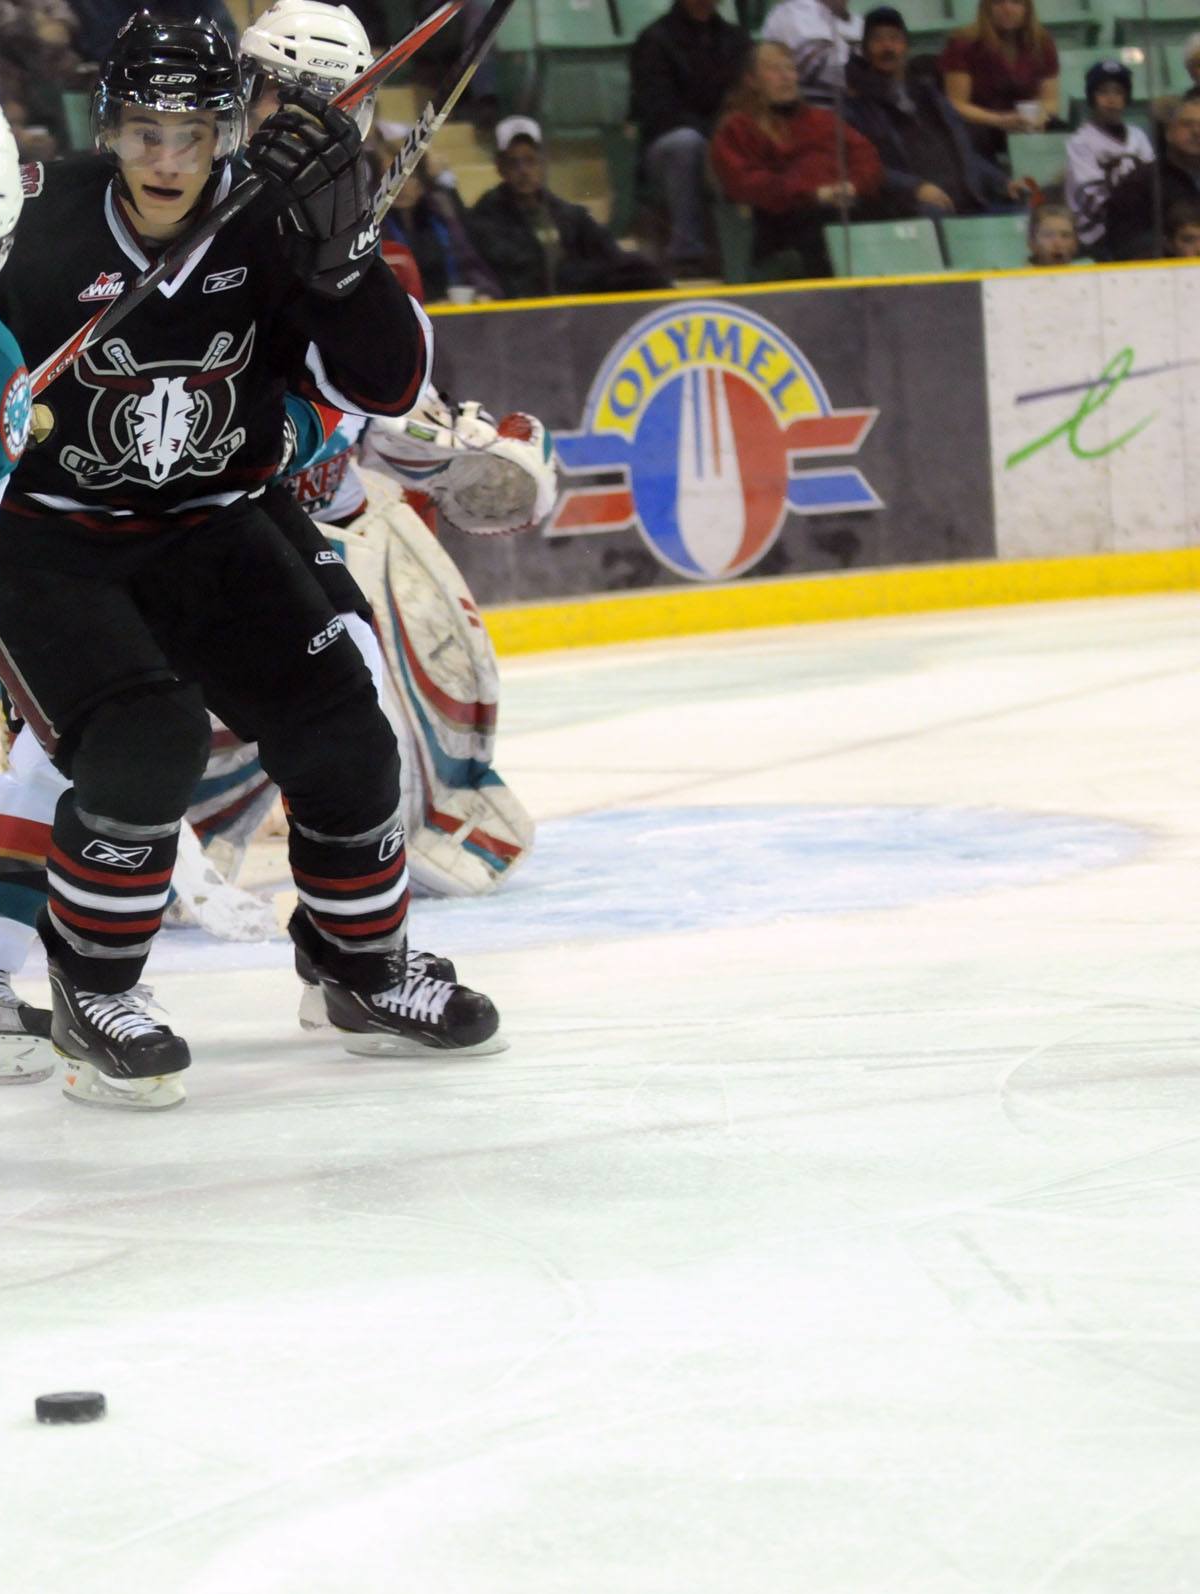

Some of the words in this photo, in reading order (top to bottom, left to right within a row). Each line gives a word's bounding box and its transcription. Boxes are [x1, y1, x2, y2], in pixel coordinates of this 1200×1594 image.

[312, 58, 346, 70] CCM
[153, 74, 194, 83] CCM
[87, 280, 125, 297] WHL
[46, 353, 75, 382] CCM
[609, 318, 798, 419] OLYMEL
